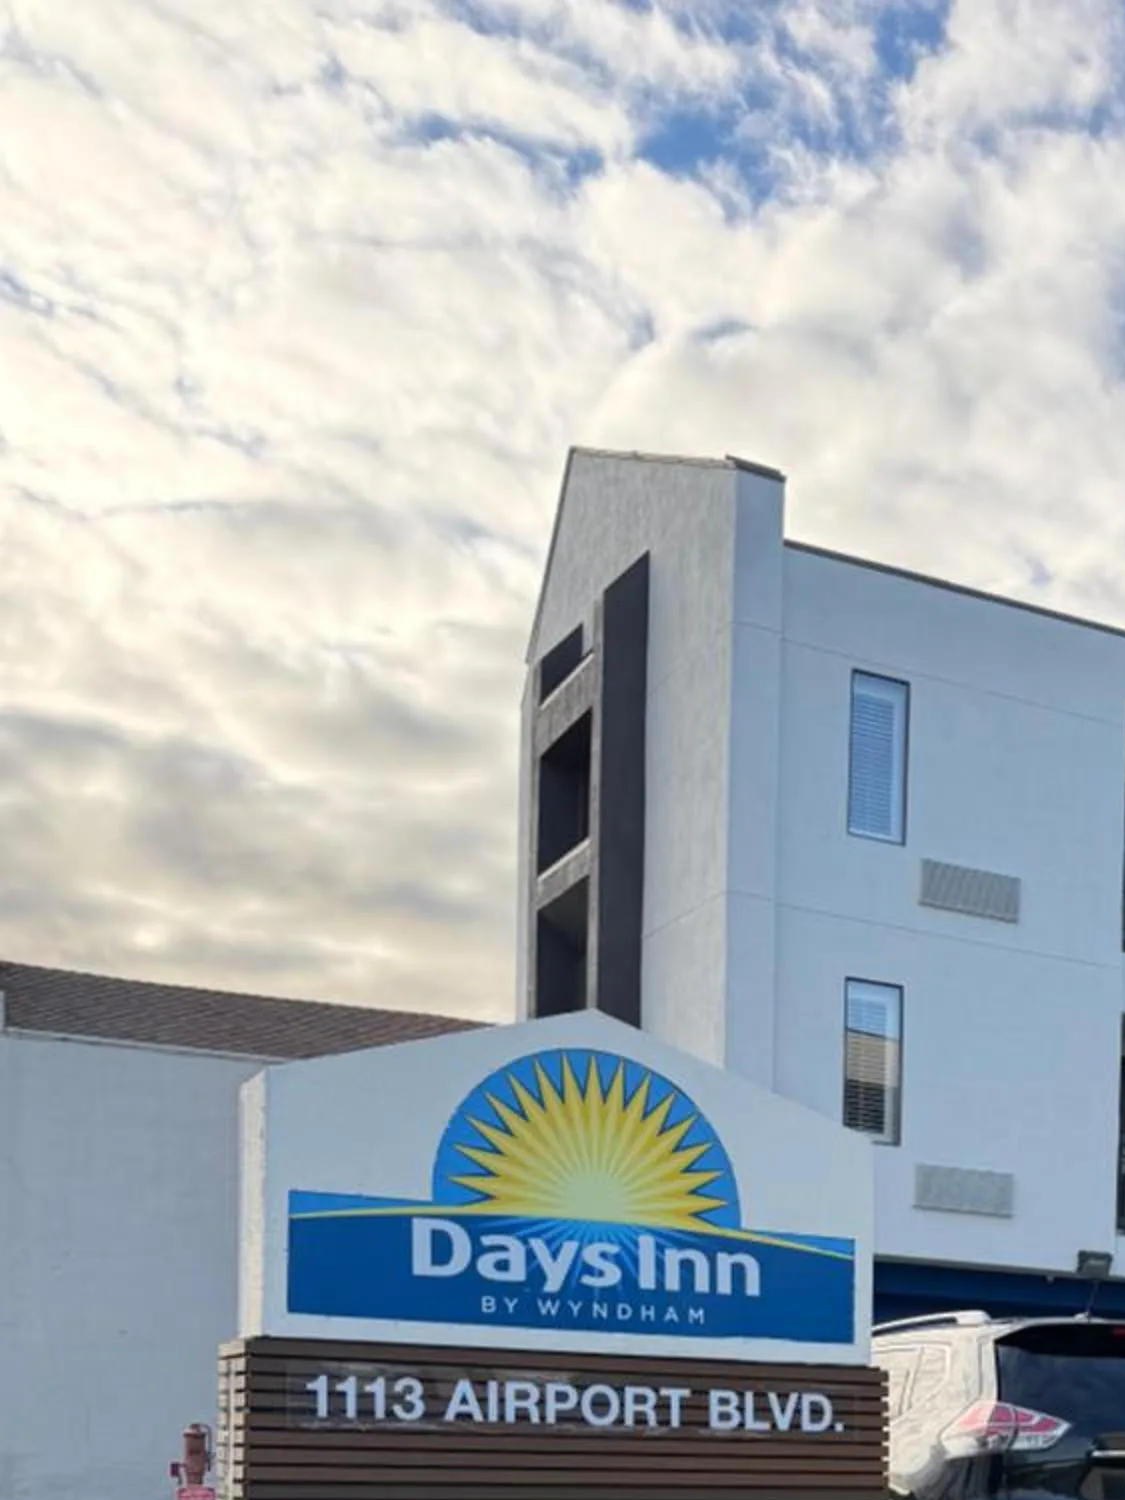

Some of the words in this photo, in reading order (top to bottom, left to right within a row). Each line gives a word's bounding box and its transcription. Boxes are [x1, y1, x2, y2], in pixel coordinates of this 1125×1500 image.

[411, 1217, 621, 1292] Days
[638, 1234, 762, 1297] Inn
[481, 1295, 517, 1314] BY
[538, 1299, 706, 1325] WYNDHAM
[305, 1375, 425, 1421] 1113
[445, 1379, 690, 1426] AIRPORT
[709, 1392, 845, 1433] BLVD.
